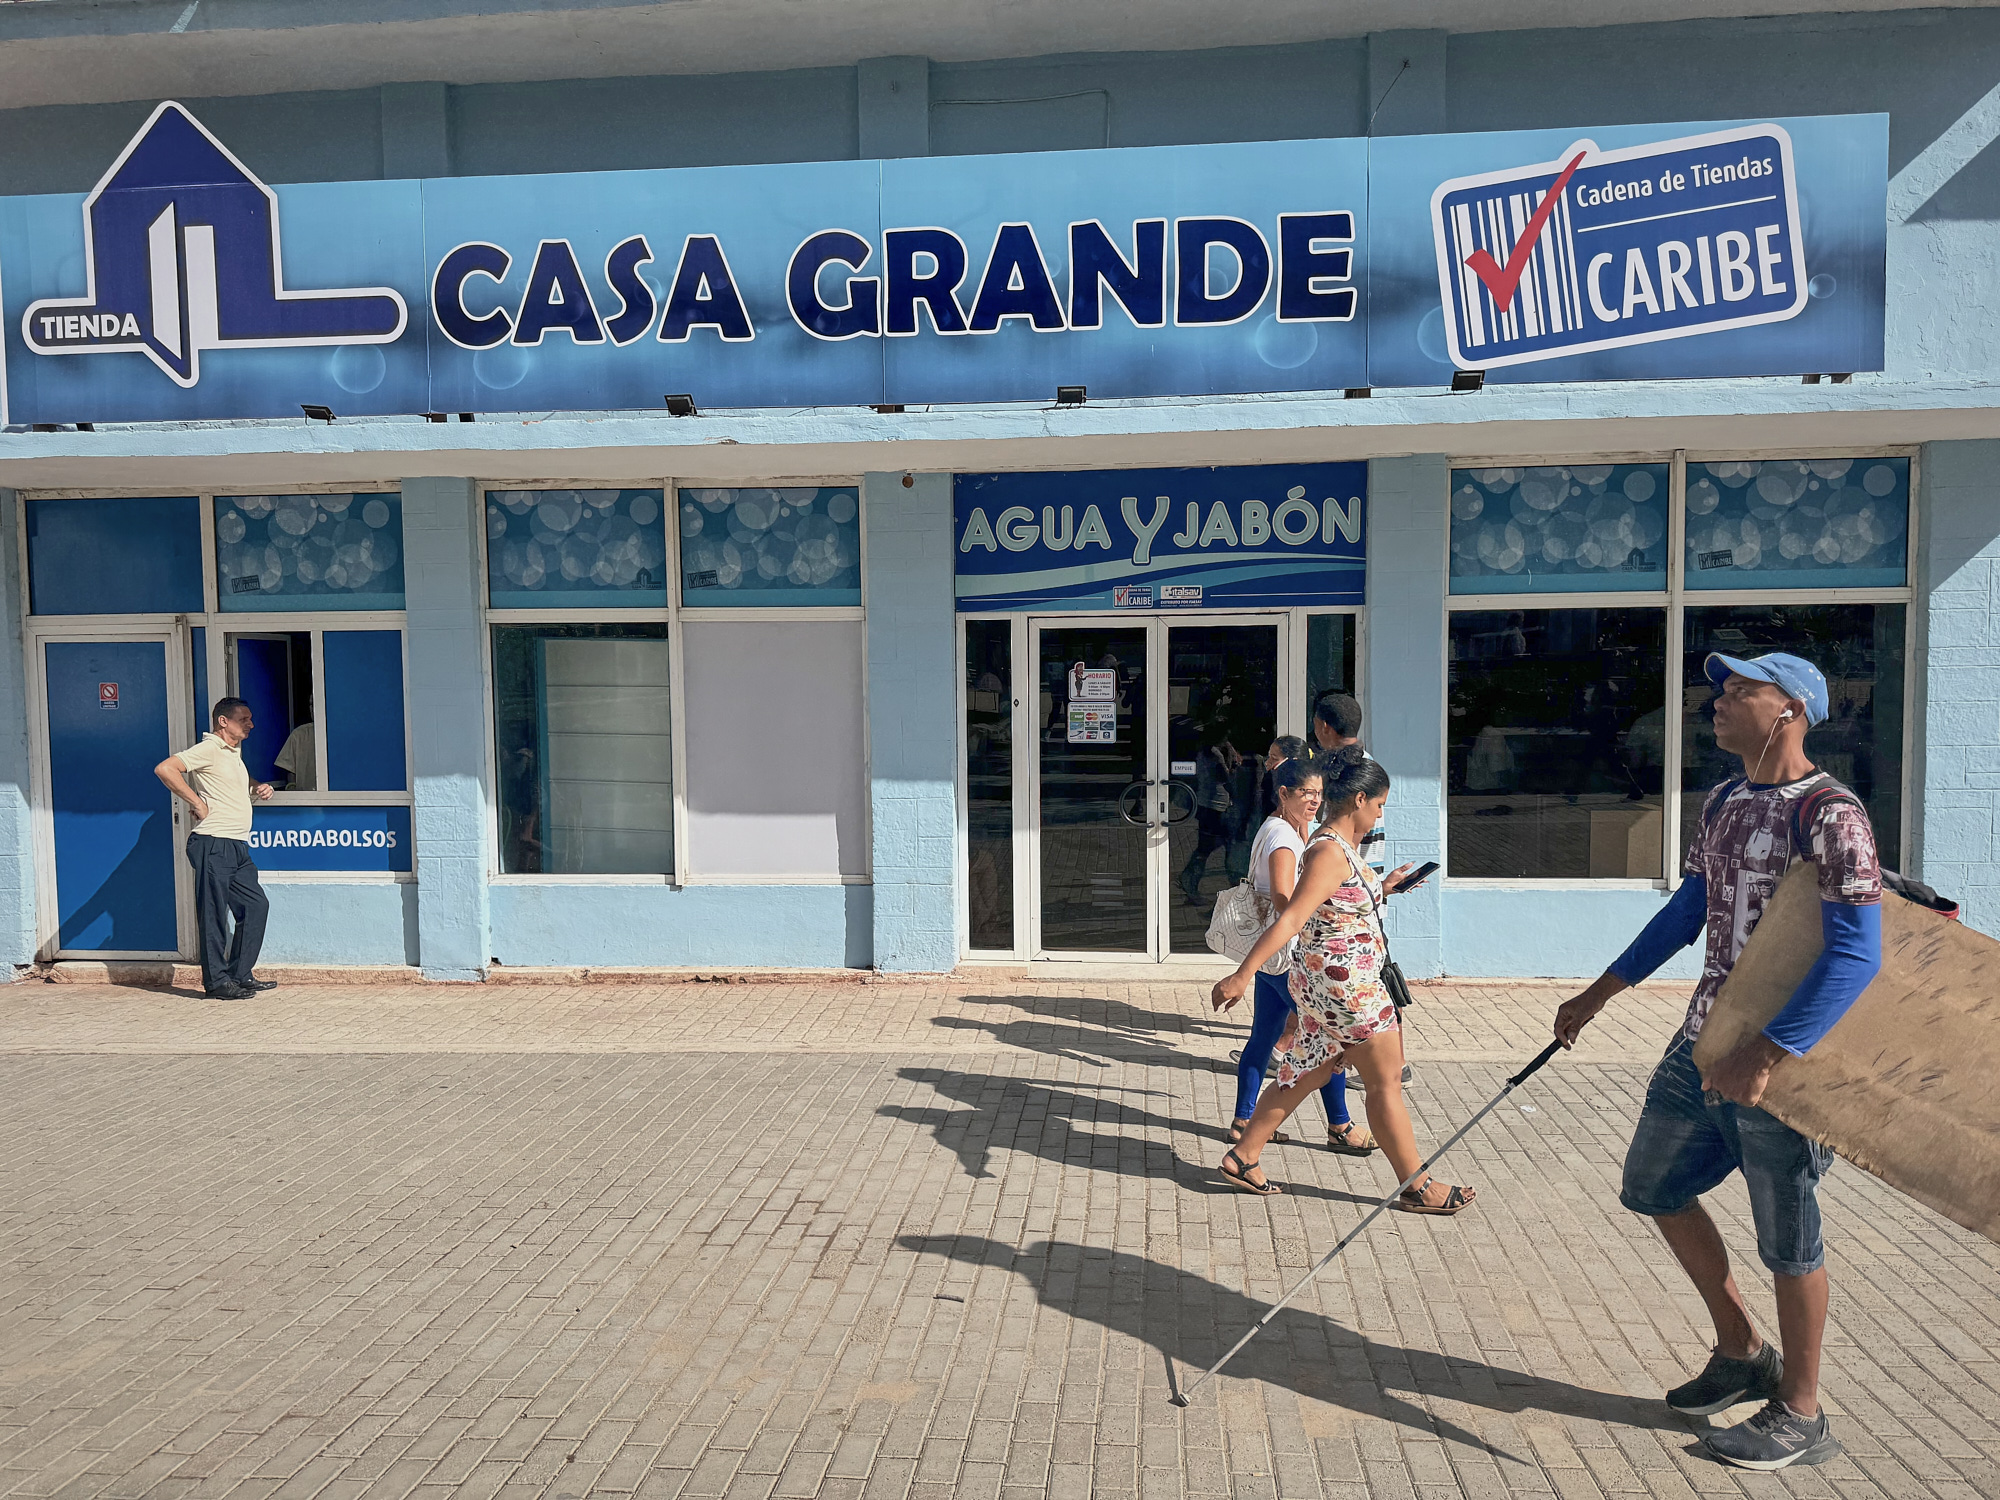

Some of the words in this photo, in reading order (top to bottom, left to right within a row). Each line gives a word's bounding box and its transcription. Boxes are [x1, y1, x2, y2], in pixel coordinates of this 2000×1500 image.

[1576, 175, 1653, 208] Cadena
[1658, 170, 1685, 193] de
[1690, 156, 1774, 188] Tiendas
[431, 233, 756, 350] CASA
[786, 209, 1359, 342] GRANDE
[1587, 223, 1788, 323] CARIBE
[40, 313, 142, 340] TIENDA
[959, 504, 1112, 554] AGUA
[1120, 495, 1170, 566] Y
[1172, 484, 1362, 548] JABÓN
[1128, 596, 1152, 606] CARIBE
[247, 829, 397, 849] GUARDABOLSOS
